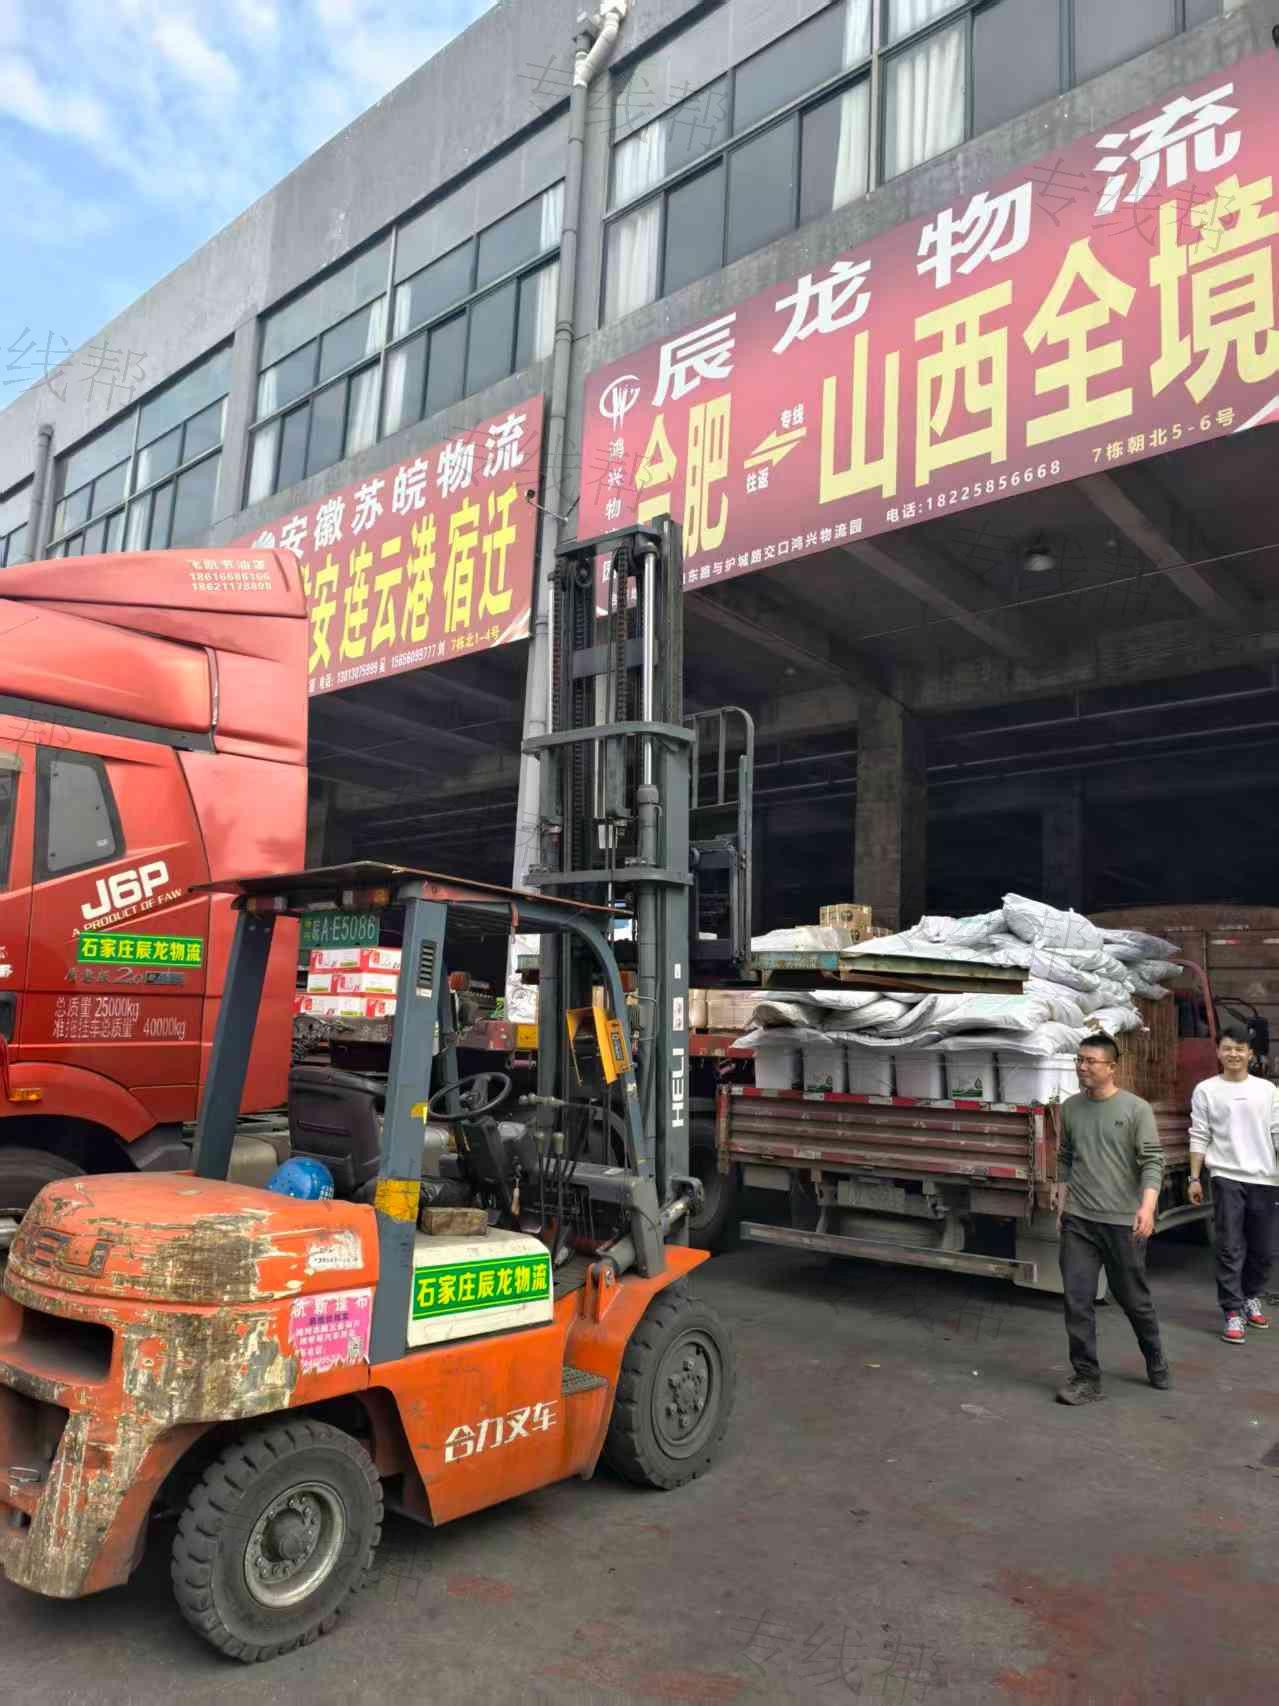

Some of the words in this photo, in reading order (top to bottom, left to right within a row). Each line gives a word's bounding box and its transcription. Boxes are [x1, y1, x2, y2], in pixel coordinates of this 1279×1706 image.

[652, 82, 1242, 408] 辰龙物流
[635, 394, 732, 557] 合肥
[819, 174, 1279, 505] 山西全境
[302, 482, 518, 672] 安连云港宿迁
[80, 860, 169, 920] J6P
[84, 904, 138, 931] PRODUCT
[140, 898, 156, 911] OF
[157, 887, 183, 906] FAW
[81, 936, 201, 962] 石家庄辰龙物流
[54, 996, 92, 1018] 总质量
[94, 996, 140, 1022] 25000kg
[143, 1016, 186, 1041] 40000kg
[671, 1047, 686, 1128] HELI
[416, 1262, 548, 1308] 石家庄辰龙物流
[443, 1399, 560, 1464] 合力叉车
